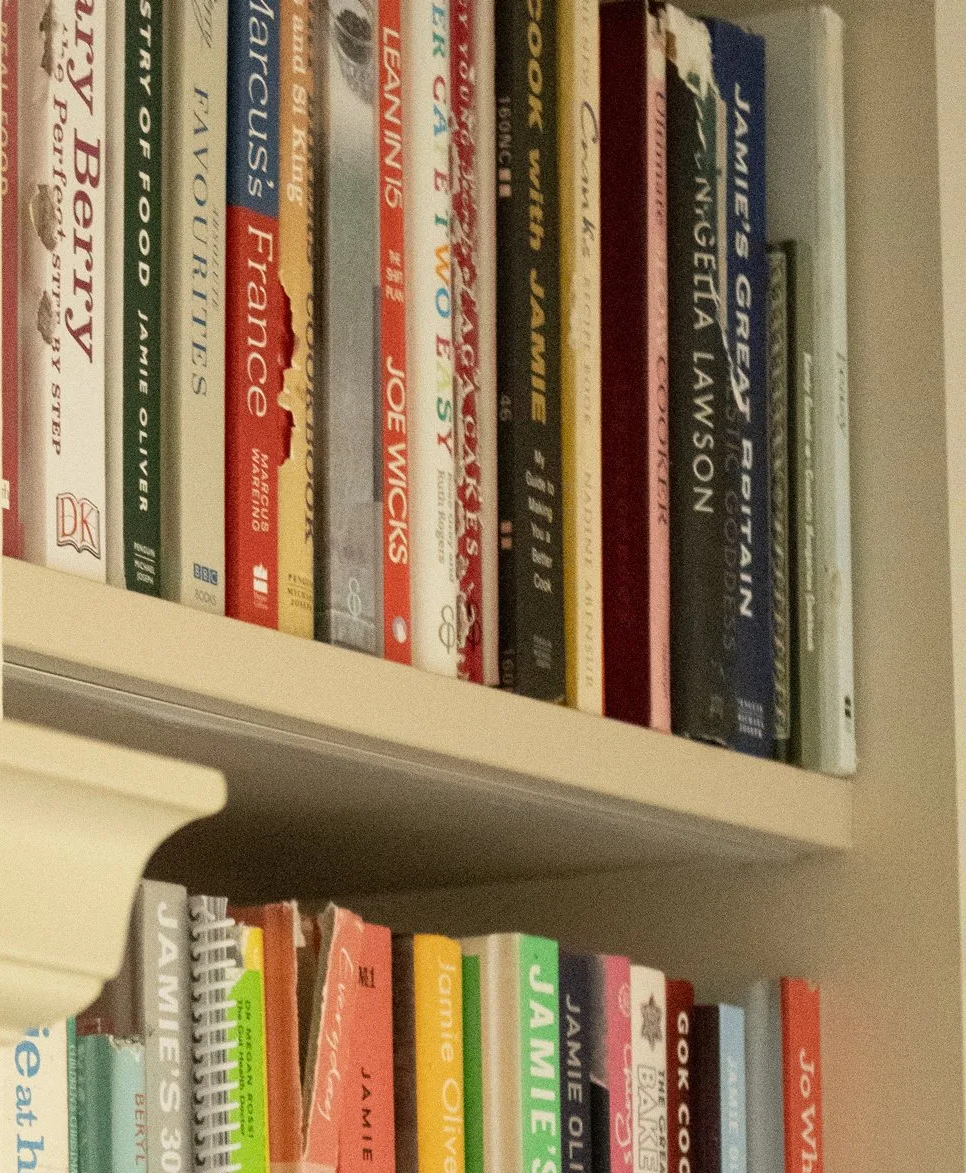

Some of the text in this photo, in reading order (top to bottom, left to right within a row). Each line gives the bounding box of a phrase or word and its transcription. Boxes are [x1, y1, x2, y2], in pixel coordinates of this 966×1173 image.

[287, 14, 307, 205] and Si King
[528, 0, 547, 426] COOK with JAMIE
[581, 100, 600, 259] Cranks
[65, 128, 101, 364] Berry
[192, 86, 209, 398] FAVOURITES
[383, 27, 408, 565] LEAN IN 15 JOE WICKS
[434, 211, 452, 320] TWO
[138, 106, 151, 512] OF FOOD JAMIE OLIVER
[247, 225, 273, 418] France
[733, 82, 753, 618] JAMIE'S GREAT BRITAIN
[51, 383, 61, 456] STEP
[436, 334, 453, 458] EASY
[692, 351, 715, 514] LAWSON
[57, 497, 98, 548] DK
[251, 446, 260, 533] WAREING
[260, 452, 269, 533] MARCUS
[462, 414, 481, 557] CAKES
[194, 563, 218, 586] BBC
[436, 516, 448, 565] Rogers
[157, 901, 181, 1112] JAMIE'S
[244, 1000, 252, 1023] DR
[245, 1027, 254, 1085] MEGAN
[318, 946, 355, 1121] Everyday
[438, 959, 459, 1064] Jamie
[565, 993, 582, 1102] JAMIE
[677, 1011, 690, 1091] GOK
[15, 1084, 38, 1127] at
[361, 1065, 376, 1162] JAMIE
[637, 1064, 660, 1172] BAKE
[657, 1070, 666, 1104] THE
[799, 1047, 817, 1099] Jo
[135, 1092, 147, 1166] BERYL
